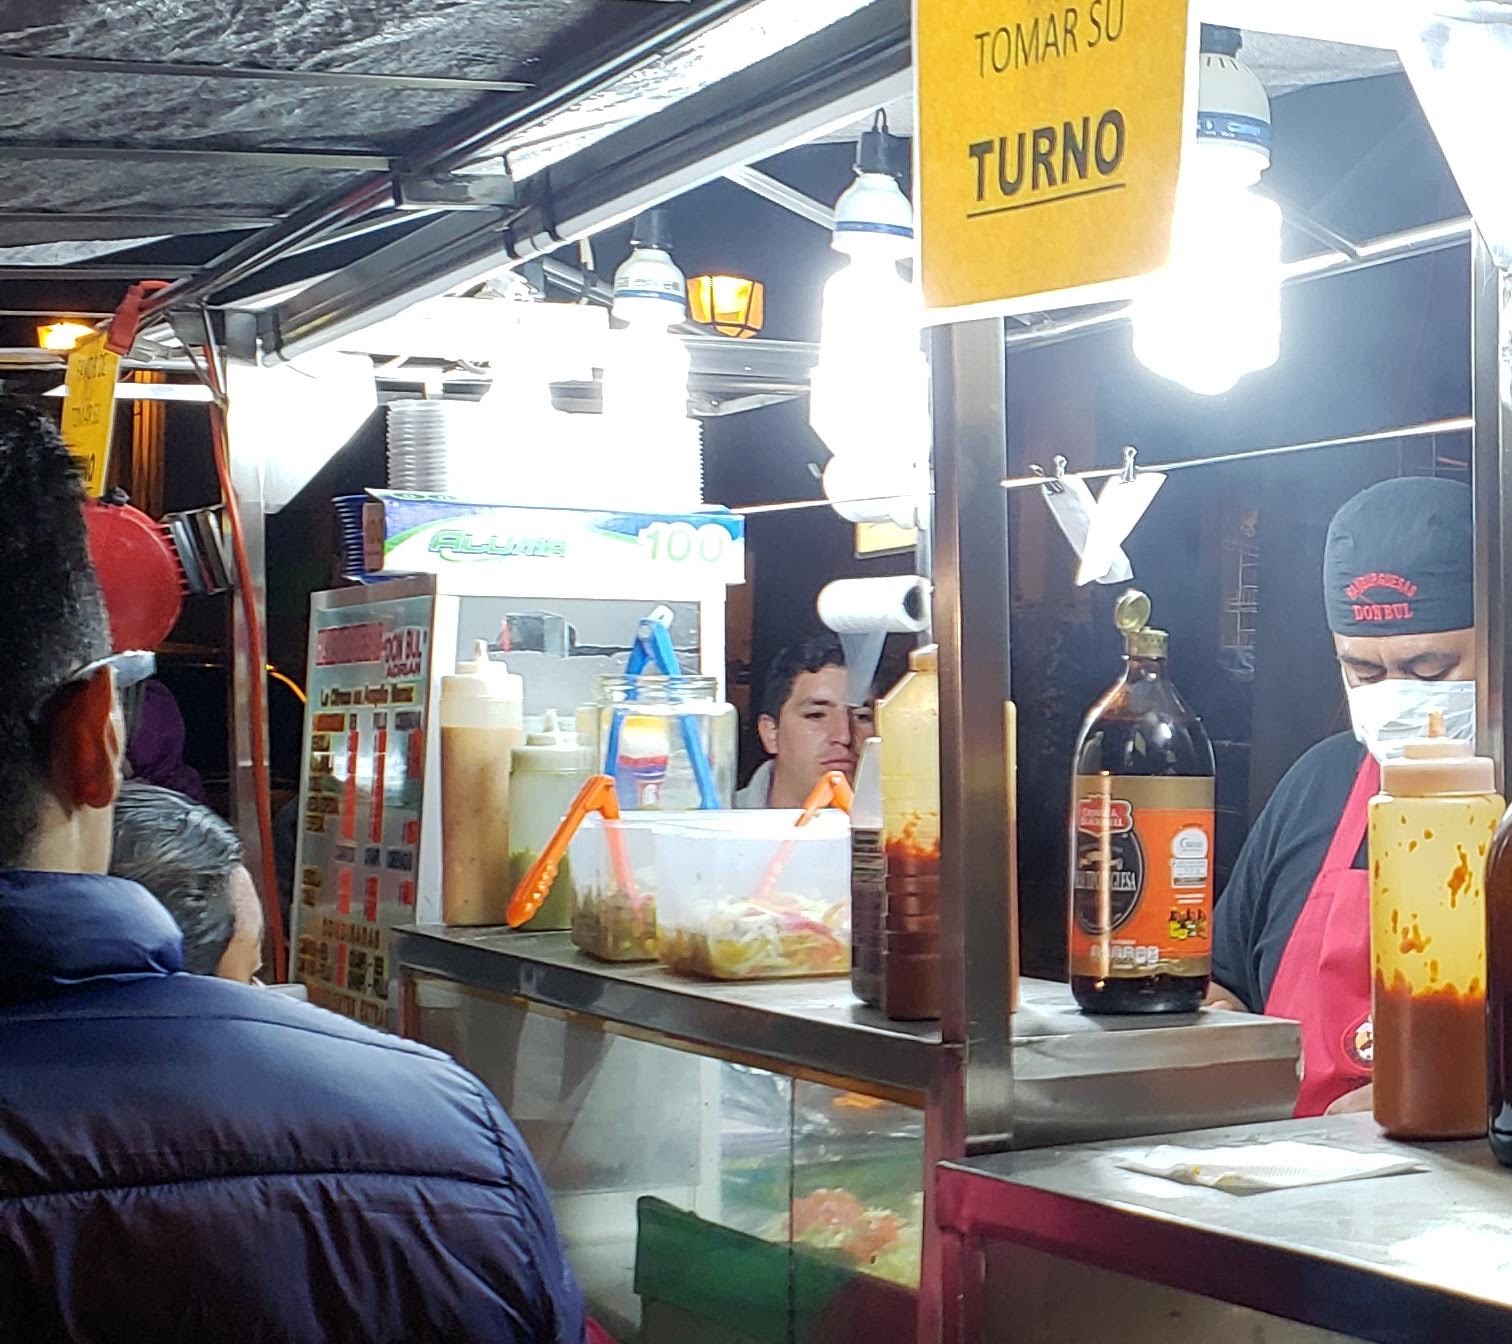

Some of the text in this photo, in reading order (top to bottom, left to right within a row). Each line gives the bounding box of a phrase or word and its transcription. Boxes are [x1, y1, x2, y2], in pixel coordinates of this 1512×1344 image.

[975, 13, 1077, 79] TOMAR
[968, 109, 1126, 202] TURNO
[648, 528, 724, 562] 100
[1352, 602, 1414, 621] DON BUL
